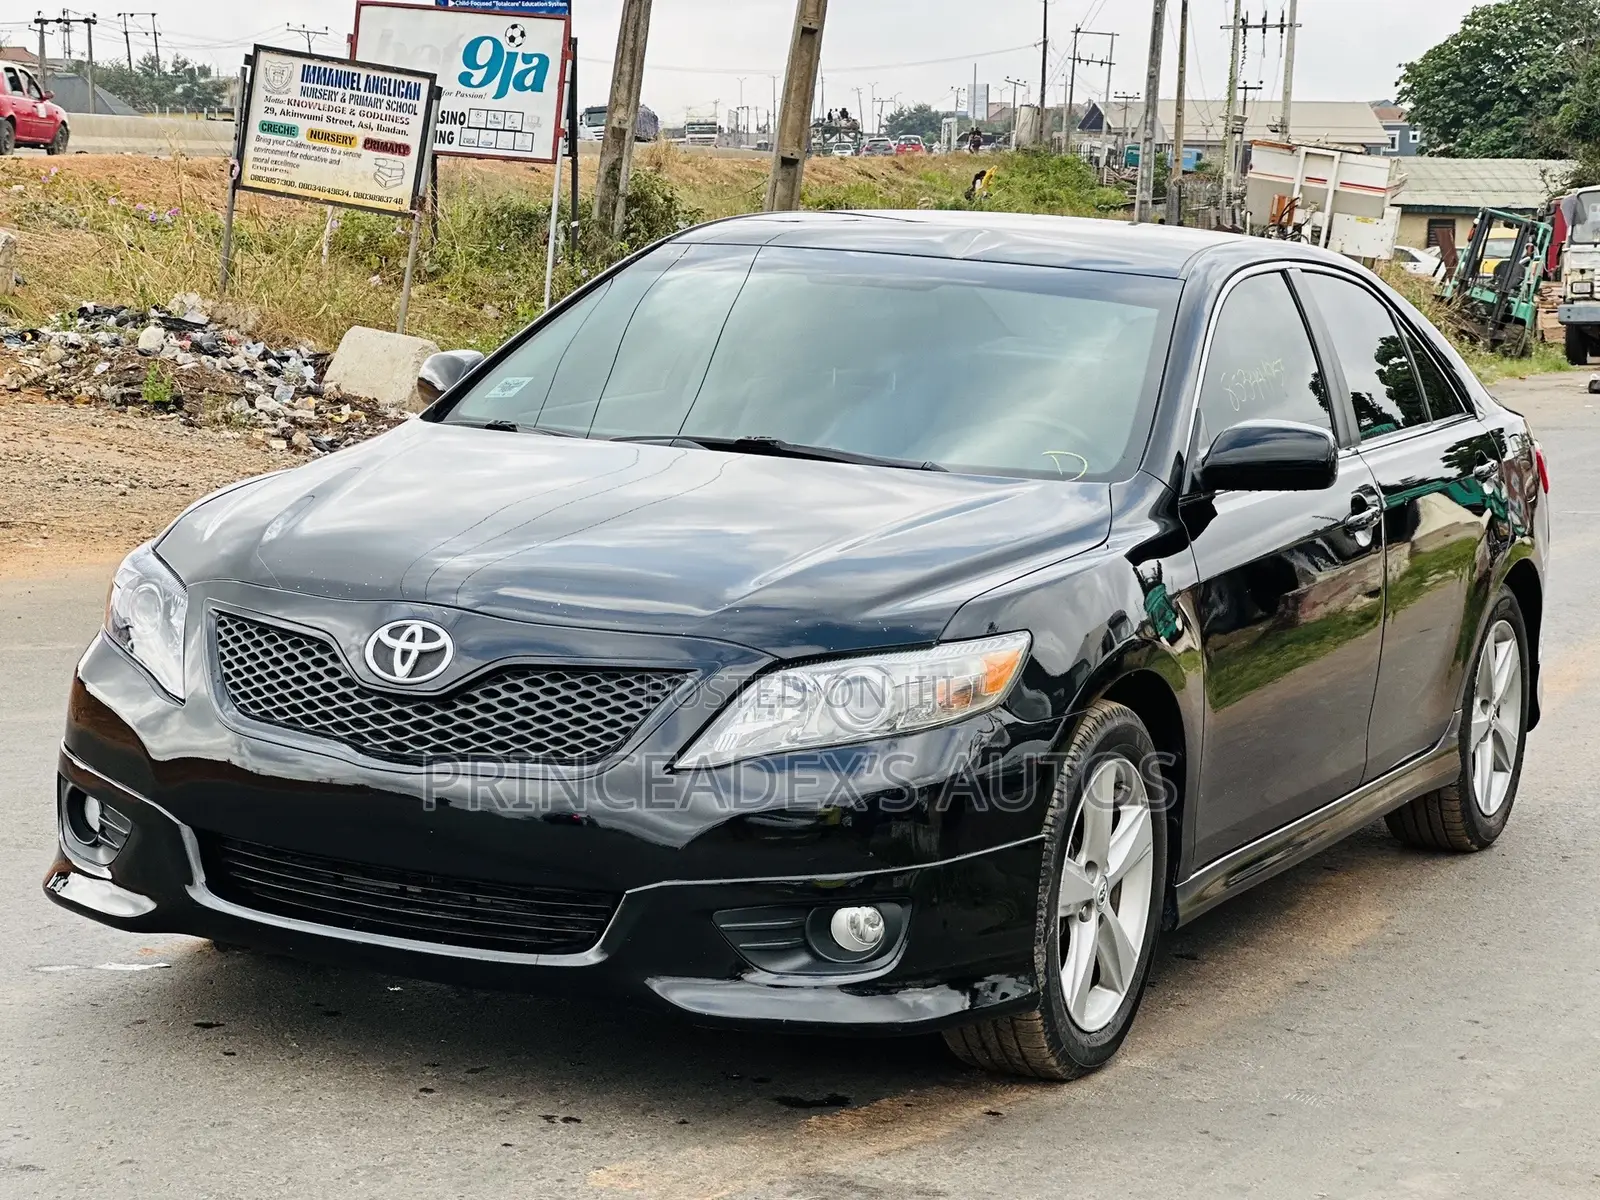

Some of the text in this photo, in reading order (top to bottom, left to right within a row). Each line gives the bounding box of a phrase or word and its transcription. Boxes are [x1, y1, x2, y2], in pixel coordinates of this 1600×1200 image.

[300, 64, 361, 92] IMMANUEL
[363, 74, 421, 101] ANGLICAN
[300, 86, 339, 102] NURSERY
[340, 92, 346, 104] &
[348, 93, 384, 110] PRIMARY
[385, 100, 418, 115] SCHOOL
[455, 91, 487, 99] Passion!
[263, 95, 410, 125] Motto: KNOWLEDGE & GODLINESS
[436, 110, 466, 126] SINO
[261, 122, 296, 136] CRECHE
[264, 106, 409, 136] 29, Akinwumi Street, Asi, Ibadan.
[272, 138, 285, 146] your
[310, 130, 354, 146] NURSERY
[252, 156, 300, 168] moral excellence
[254, 146, 340, 166] environment for educative and
